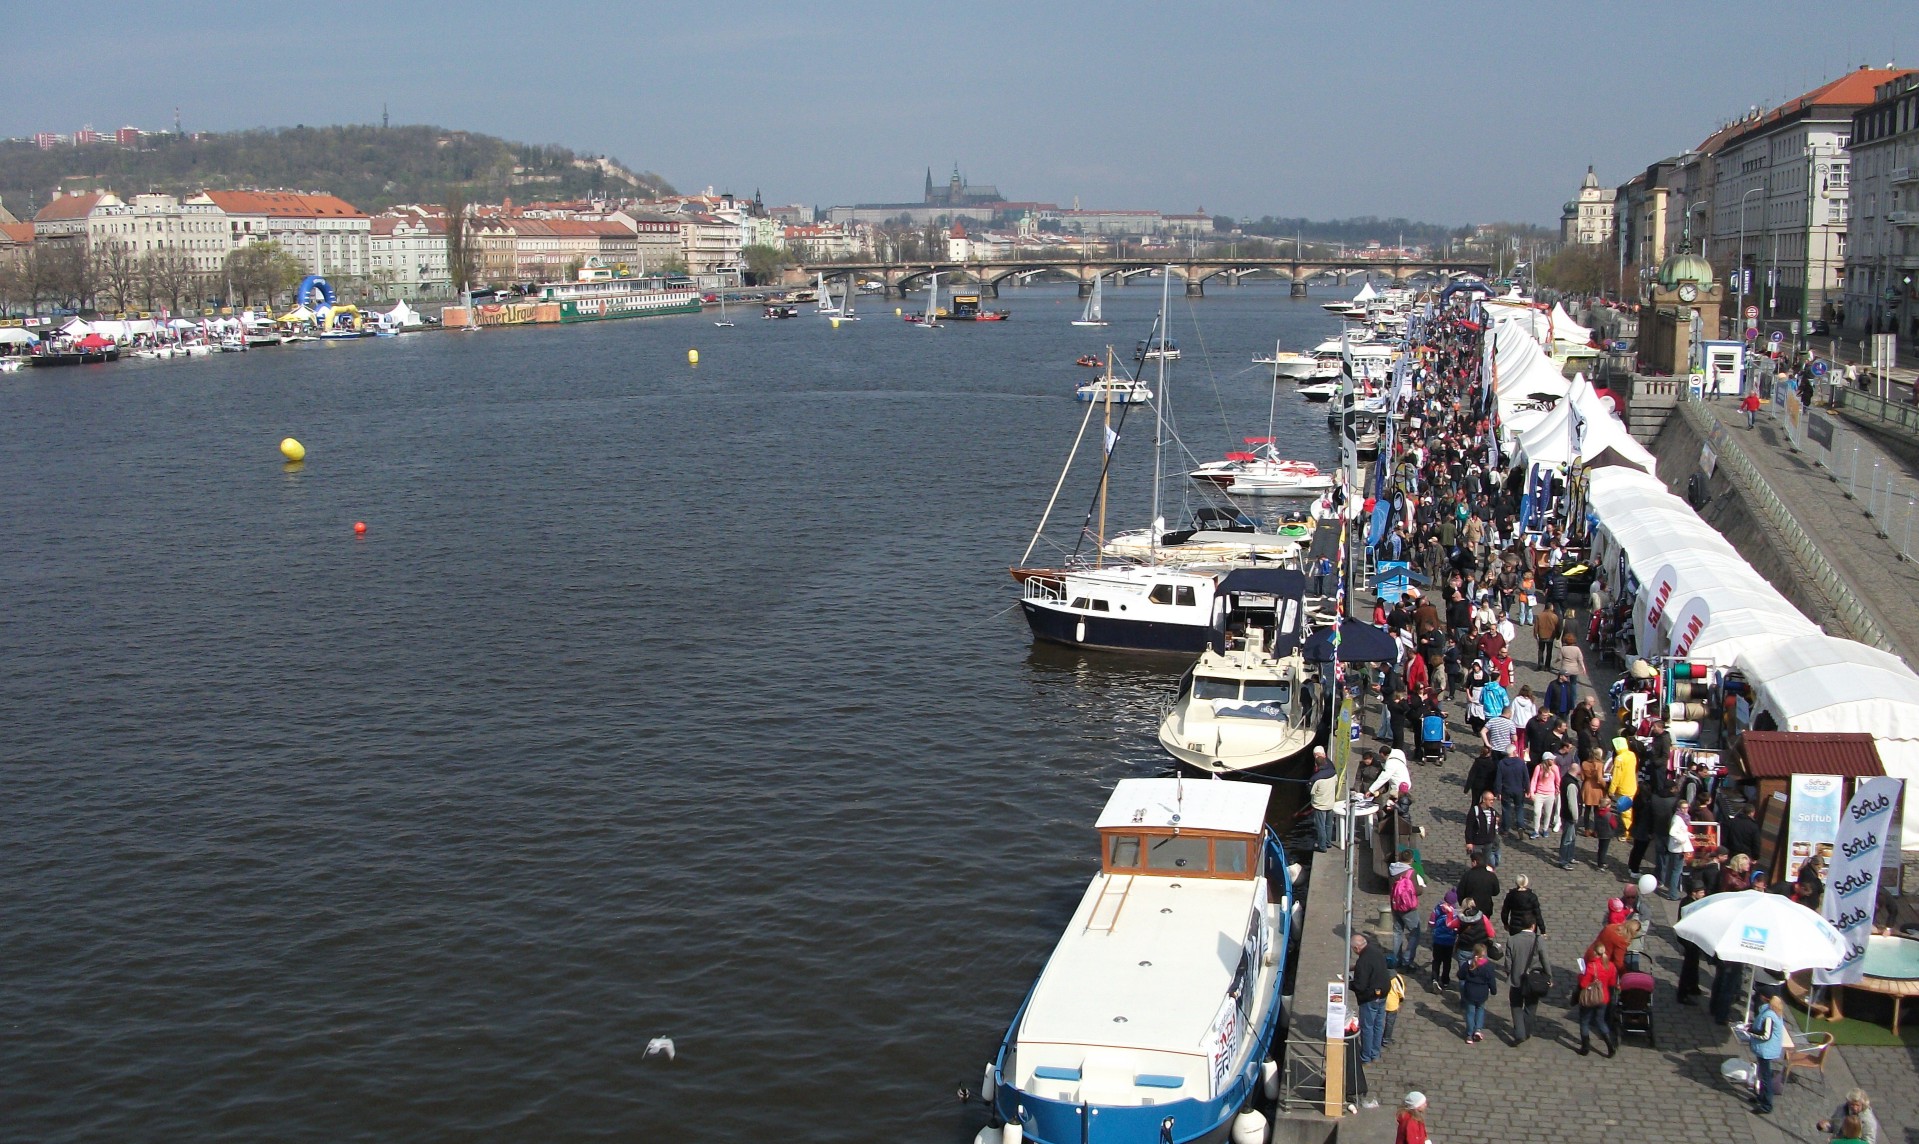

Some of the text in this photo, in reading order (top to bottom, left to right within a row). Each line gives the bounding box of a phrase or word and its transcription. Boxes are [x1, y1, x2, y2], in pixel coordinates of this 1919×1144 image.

[1648, 580, 1672, 629] SLAM
[1798, 813, 1832, 823] Softub
[1851, 793, 1889, 820] Softub
[1842, 831, 1877, 858] Softub
[1834, 869, 1873, 896] Softub
